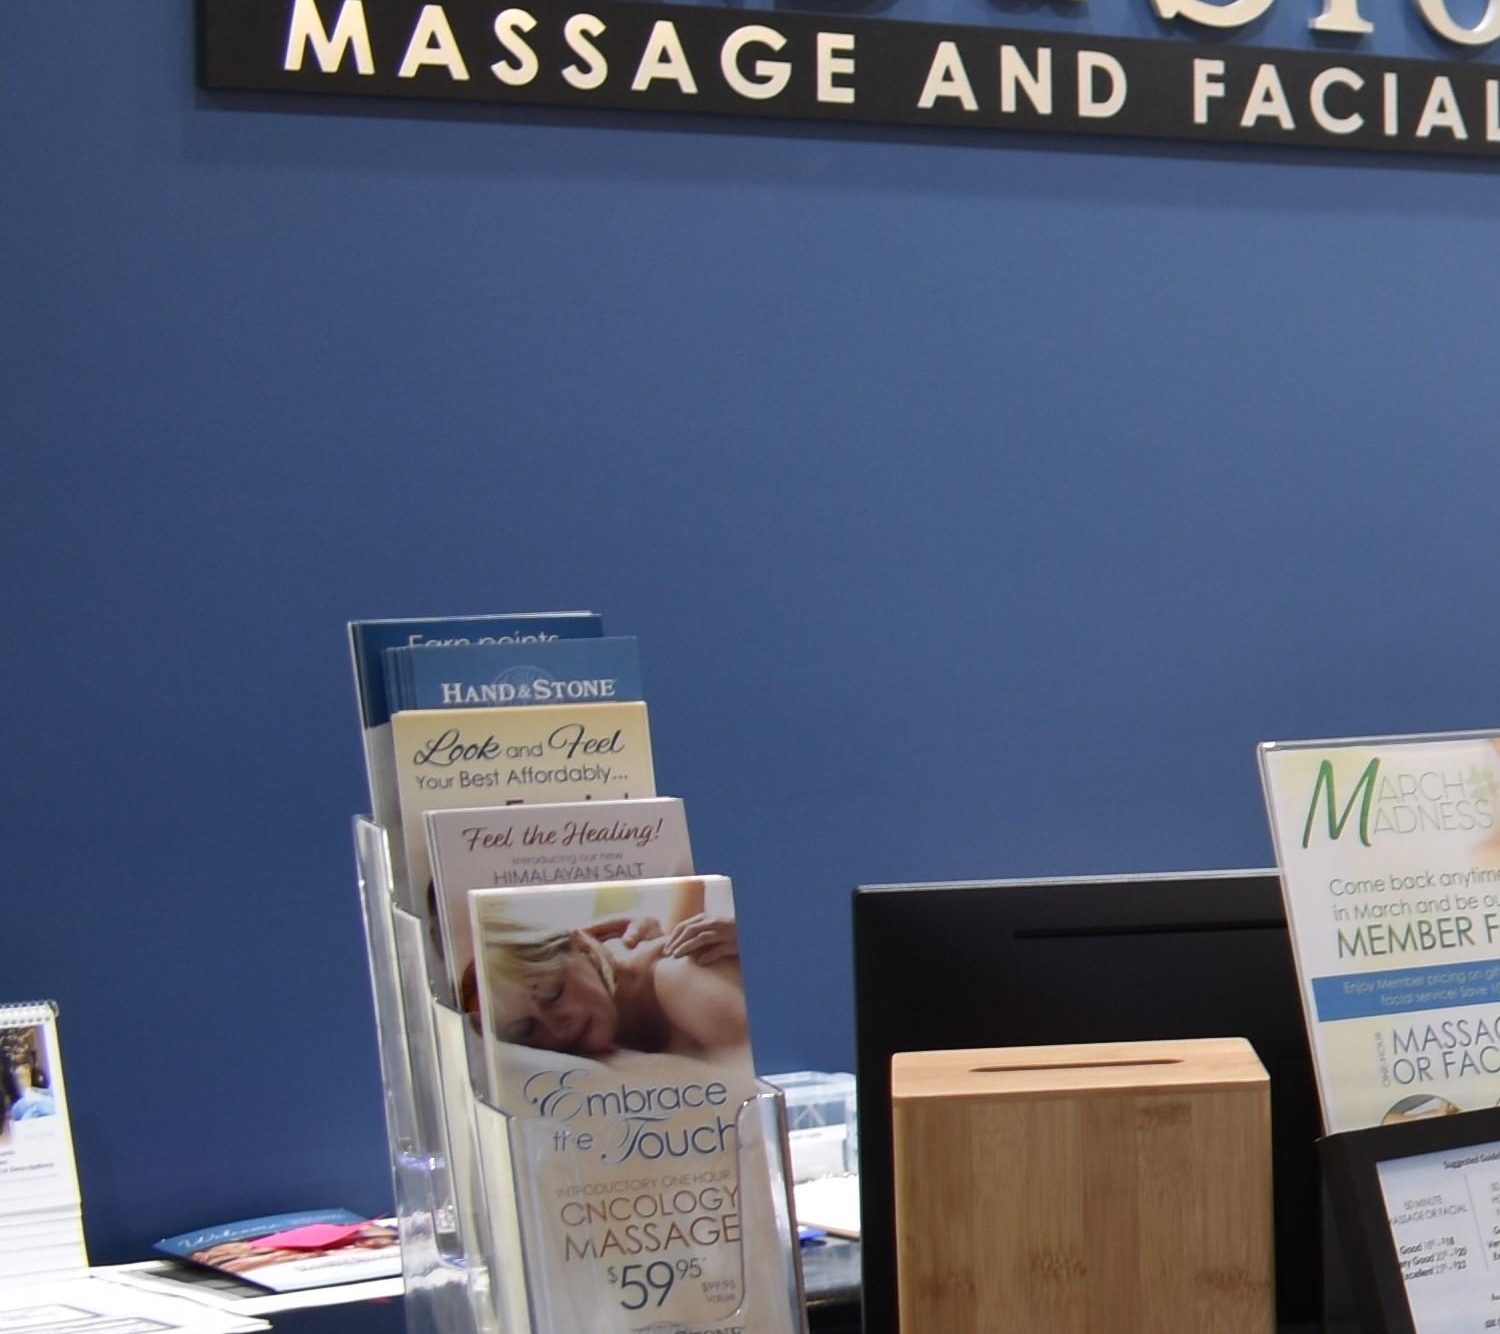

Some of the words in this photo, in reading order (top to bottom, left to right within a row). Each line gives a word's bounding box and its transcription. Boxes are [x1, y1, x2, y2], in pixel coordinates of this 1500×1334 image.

[917, 40, 1128, 119] AND
[413, 728, 501, 766] Look
[506, 742, 543, 758] and
[548, 723, 625, 759] Feel
[416, 774, 453, 791] Your
[460, 770, 499, 787] Best
[507, 764, 629, 784] Affordably...
[462, 826, 513, 851] Feel
[522, 824, 557, 846] the
[562, 818, 665, 848] Healing!
[493, 867, 599, 885] HIMALAYAN
[602, 862, 644, 878] SALT
[1329, 876, 1386, 897] Come
[1390, 872, 1437, 892] back
[1333, 905, 1350, 921] in
[1353, 899, 1412, 920] March
[1415, 895, 1450, 915] and
[1455, 893, 1480, 911] be
[1337, 915, 1475, 959] MEMBER
[1376, 976, 1425, 989] Member
[1427, 970, 1467, 985] pricing
[1392, 1057, 1434, 1085] OR
[523, 1069, 728, 1120] Embrace
[564, 1214, 741, 1262] MASSAGE
